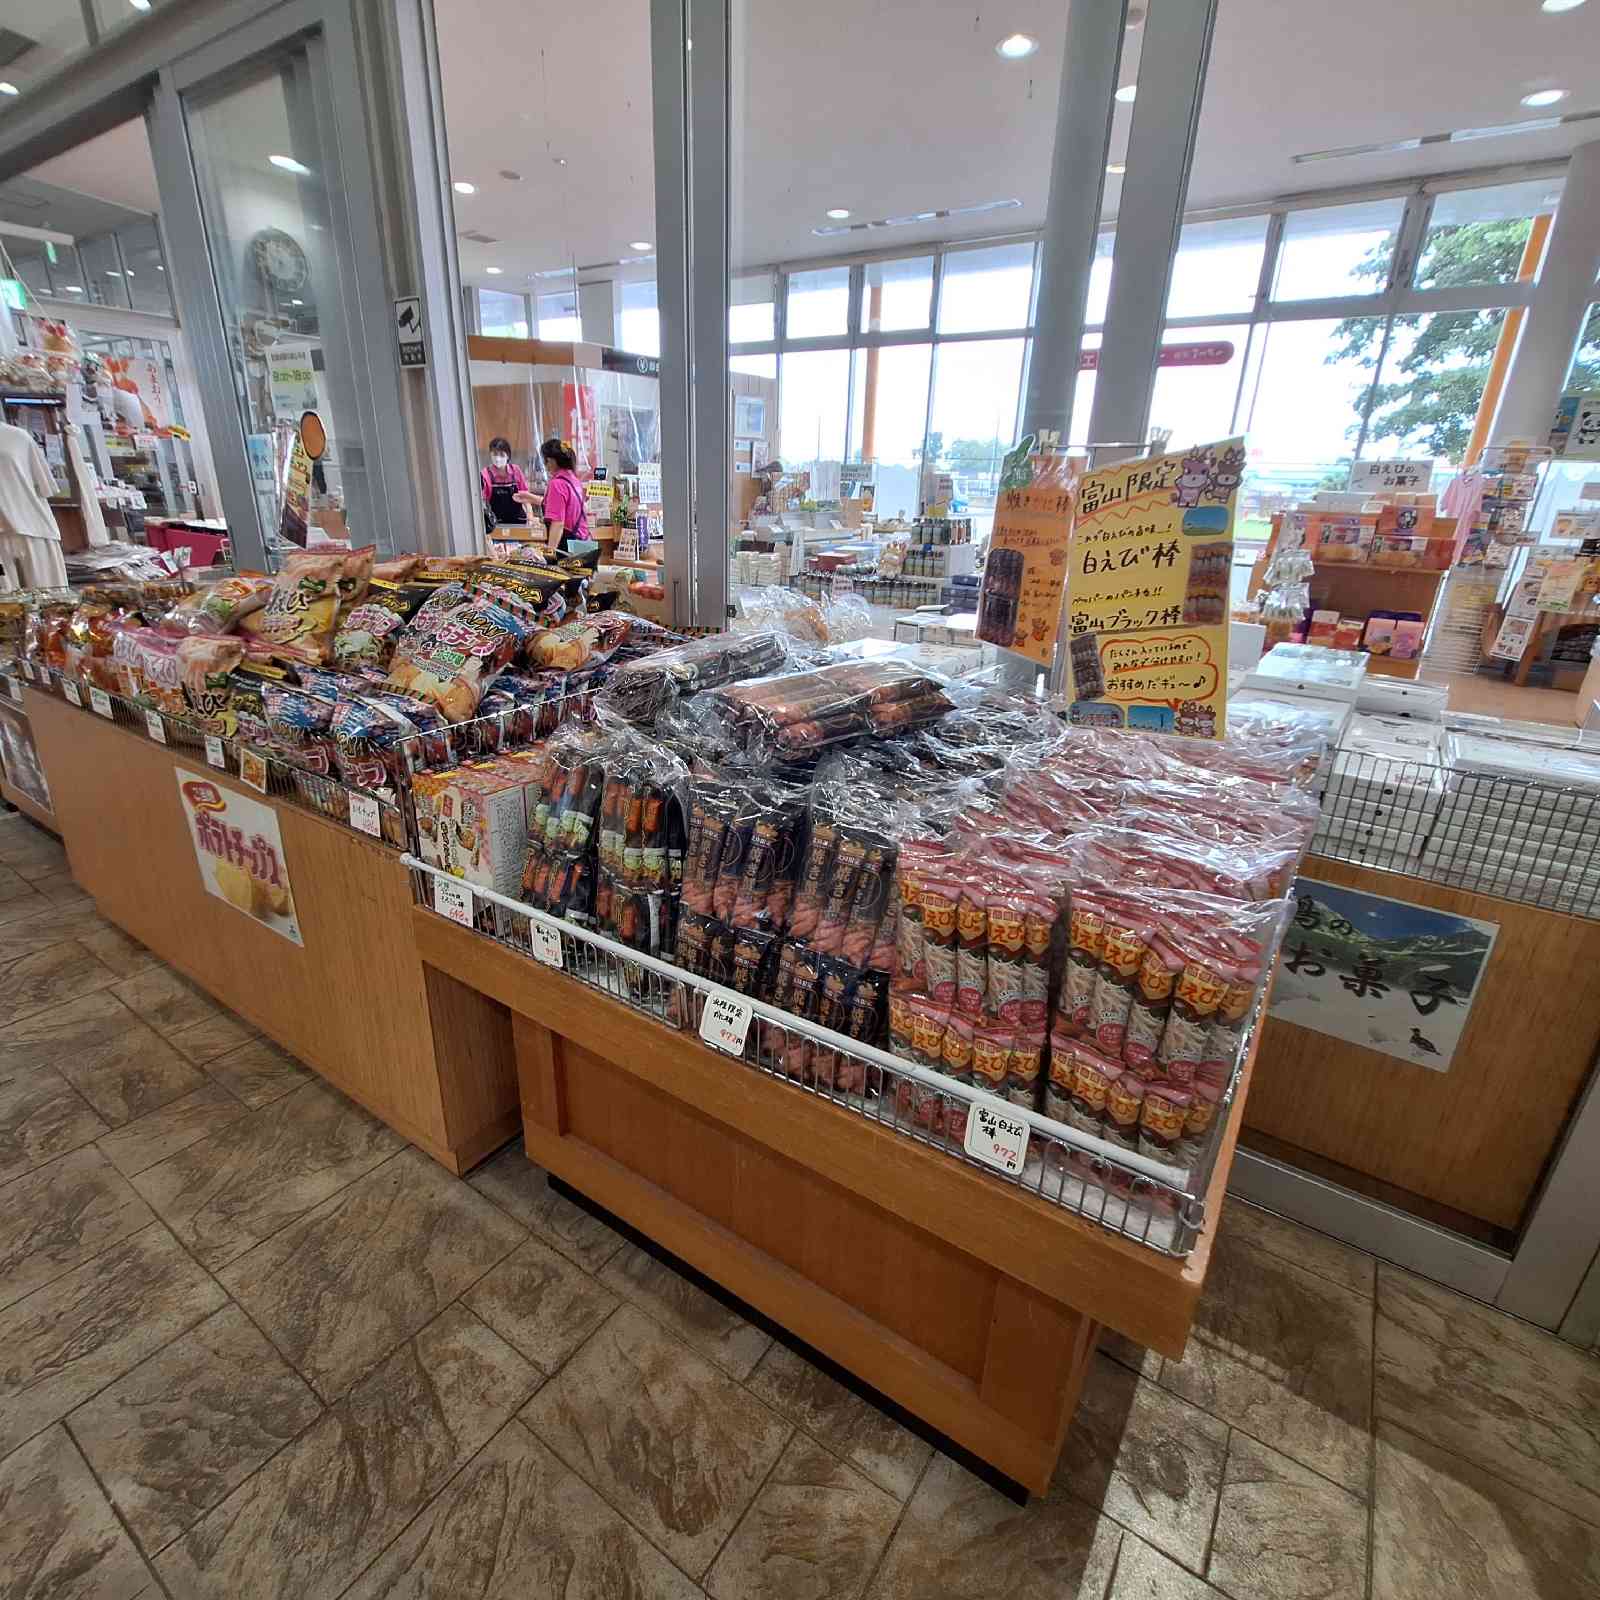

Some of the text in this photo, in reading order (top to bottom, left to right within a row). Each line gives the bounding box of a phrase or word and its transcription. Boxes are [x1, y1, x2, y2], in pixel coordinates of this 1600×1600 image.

[1368, 464, 1416, 475] 白えびの
[1383, 475, 1421, 487] お菓子
[1081, 461, 1177, 514] 富山限定
[1083, 539, 1181, 575] 白えび棒
[1071, 604, 1181, 634] 富山ブラック棒
[1284, 941, 1465, 1016] お菓子
[979, 1107, 1023, 1137] 富山白えび
[993, 1143, 1018, 1162] 972
